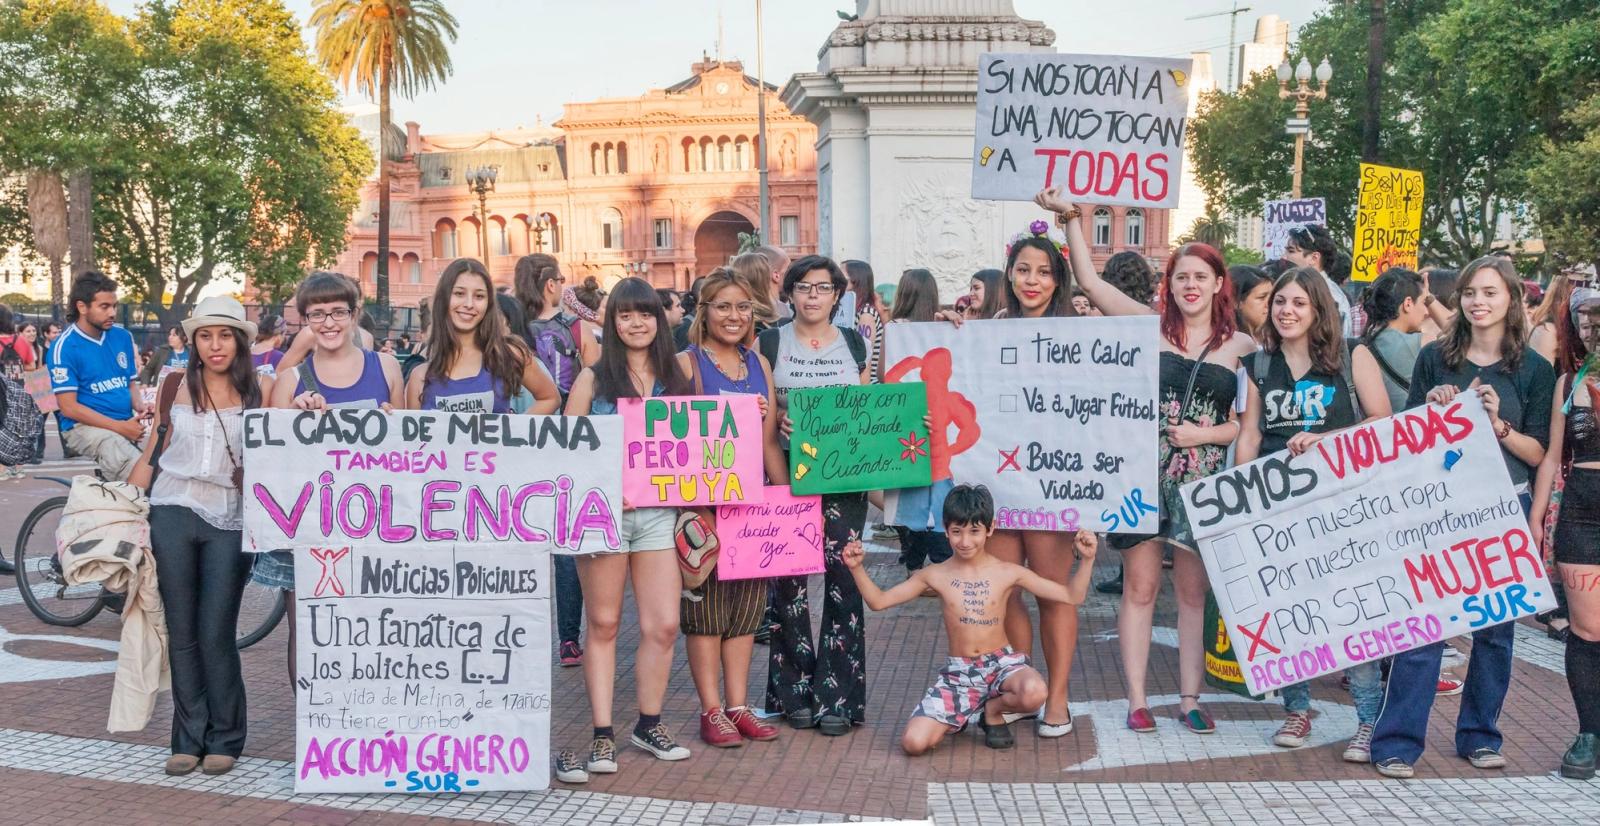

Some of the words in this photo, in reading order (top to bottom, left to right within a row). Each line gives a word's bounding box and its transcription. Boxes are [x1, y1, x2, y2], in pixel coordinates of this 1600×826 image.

[985, 59, 1014, 94] SI
[1021, 63, 1070, 97] NOS
[1073, 64, 1139, 99] TOCAN
[1142, 69, 1164, 104] A
[991, 104, 1043, 143] UNA,
[1047, 107, 1102, 140] NOS
[1105, 110, 1185, 148] TOCAN
[997, 148, 1017, 172] A
[1034, 148, 1169, 202] TODAS
[1267, 199, 1325, 224] MUJER
[1360, 212, 1377, 227] DE
[1362, 228, 1418, 251] BRUJAS
[1031, 332, 1081, 364] Tiene
[1091, 338, 1142, 367] Calor
[645, 399, 740, 440] PUTA
[794, 392, 823, 431] Yo
[875, 392, 907, 409] con
[1023, 387, 1046, 413] Va
[1052, 396, 1064, 413] a
[1110, 392, 1156, 422] Fútbol
[1265, 384, 1327, 421] SUR
[244, 412, 285, 448] EL
[293, 409, 388, 445] CASO
[402, 415, 436, 442] DE
[448, 414, 601, 451] MELINA
[856, 411, 902, 435] Dónde
[464, 451, 497, 474] ES
[628, 441, 689, 469] PERO
[702, 439, 736, 470] NO
[847, 435, 860, 455] y
[1026, 441, 1084, 472] Busca
[1093, 451, 1125, 474] ser
[822, 450, 902, 480] Cuándo...
[1191, 456, 1318, 527] SOMOS
[1317, 402, 1474, 480] VIOLADAS
[650, 472, 744, 502] TUYA
[1039, 479, 1105, 500] Violado
[720, 505, 740, 519] En
[746, 502, 771, 516] mi
[775, 501, 816, 520] cuerpo
[1101, 487, 1158, 532] SUR
[1253, 522, 1299, 557] Por
[1307, 493, 1395, 540] nuestra
[1400, 479, 1452, 515] ropa
[736, 521, 781, 539] decido
[1258, 563, 1299, 597] Por
[1306, 538, 1380, 580] nuestro
[1386, 499, 1520, 555] comportamiento
[360, 555, 450, 595] Noticias
[1274, 599, 1329, 644] POR
[1333, 575, 1412, 627] SER
[1404, 528, 1543, 603] MUJER
[308, 604, 370, 648] Una
[378, 607, 482, 648] fanática
[495, 615, 527, 648] de
[311, 653, 341, 680] los
[351, 652, 450, 680] boliches
[1250, 641, 1337, 690] ACCIÓN
[1344, 614, 1442, 663] GENERO
[343, 688, 375, 706] vida
[381, 687, 398, 706] de
[475, 690, 493, 709] de
[309, 711, 331, 728] no
[338, 706, 388, 729] tiene
[301, 730, 408, 780] ACCIÓN
[416, 733, 530, 775] GENERO
